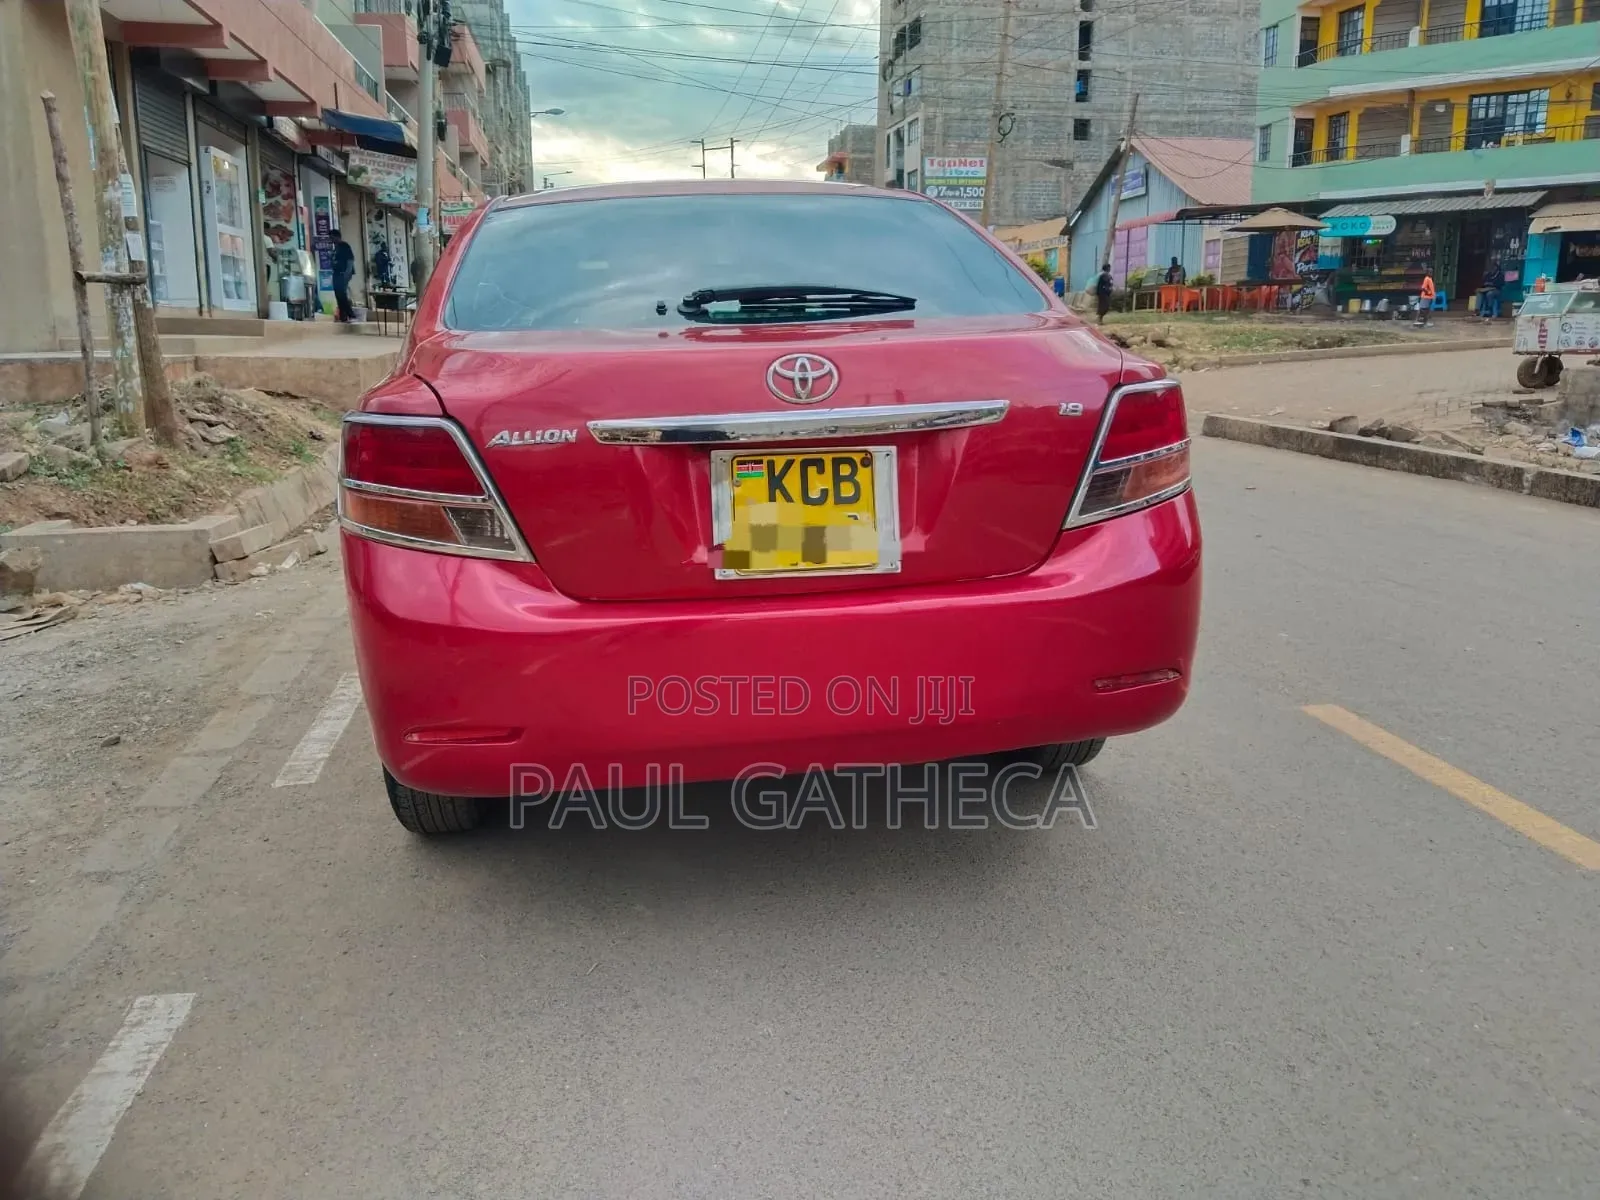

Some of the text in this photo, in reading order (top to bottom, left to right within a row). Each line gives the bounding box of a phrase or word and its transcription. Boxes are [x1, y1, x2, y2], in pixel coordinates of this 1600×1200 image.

[1331, 221, 1368, 232] KOKO
[485, 428, 578, 448] ALLION
[766, 456, 861, 506] KCB
